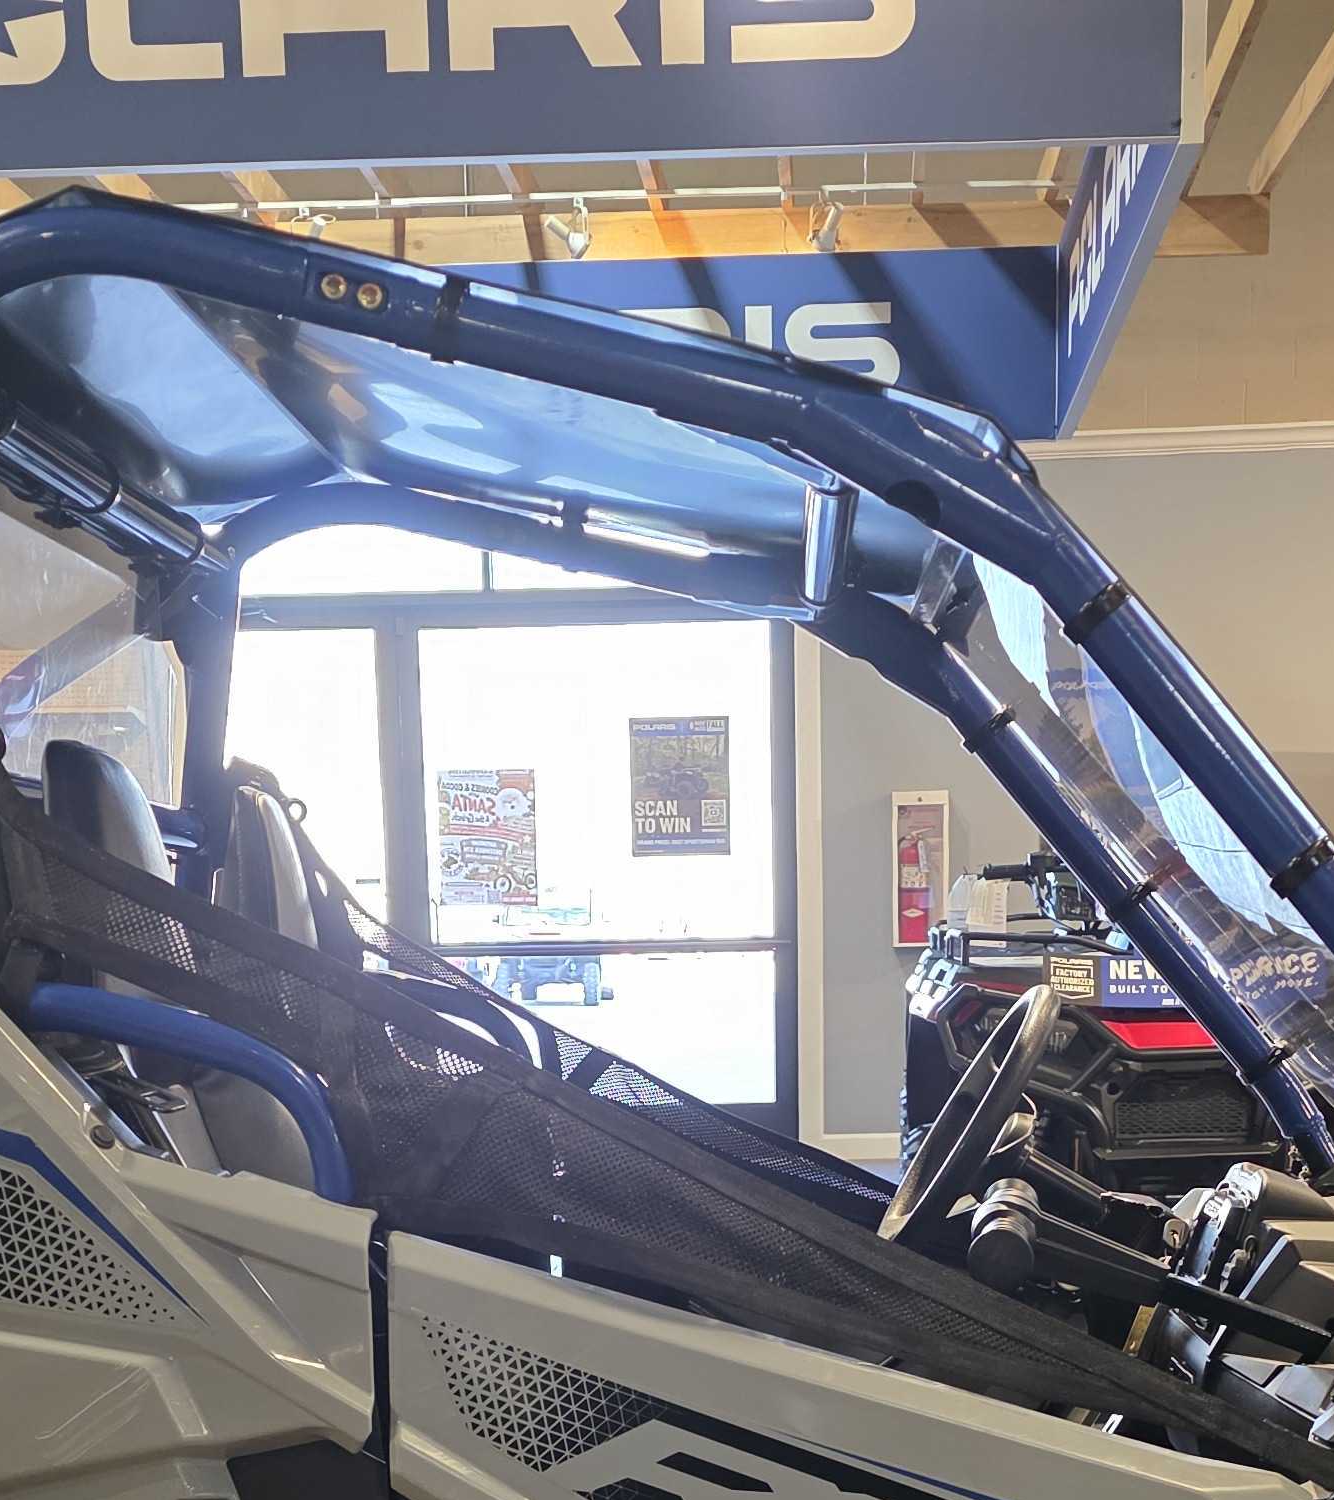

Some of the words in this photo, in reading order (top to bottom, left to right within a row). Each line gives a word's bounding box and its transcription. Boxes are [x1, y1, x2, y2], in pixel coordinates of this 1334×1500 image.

[635, 799, 678, 816] SCAN
[635, 817, 656, 834] TO
[660, 817, 691, 834] WIN
[1055, 968, 1088, 978] FACTORY
[1050, 976, 1095, 986] AUTHORIZED
[1053, 983, 1092, 993] CLEARANCE
[1109, 985, 1146, 994] BUILT
[1151, 985, 1168, 994] TO
